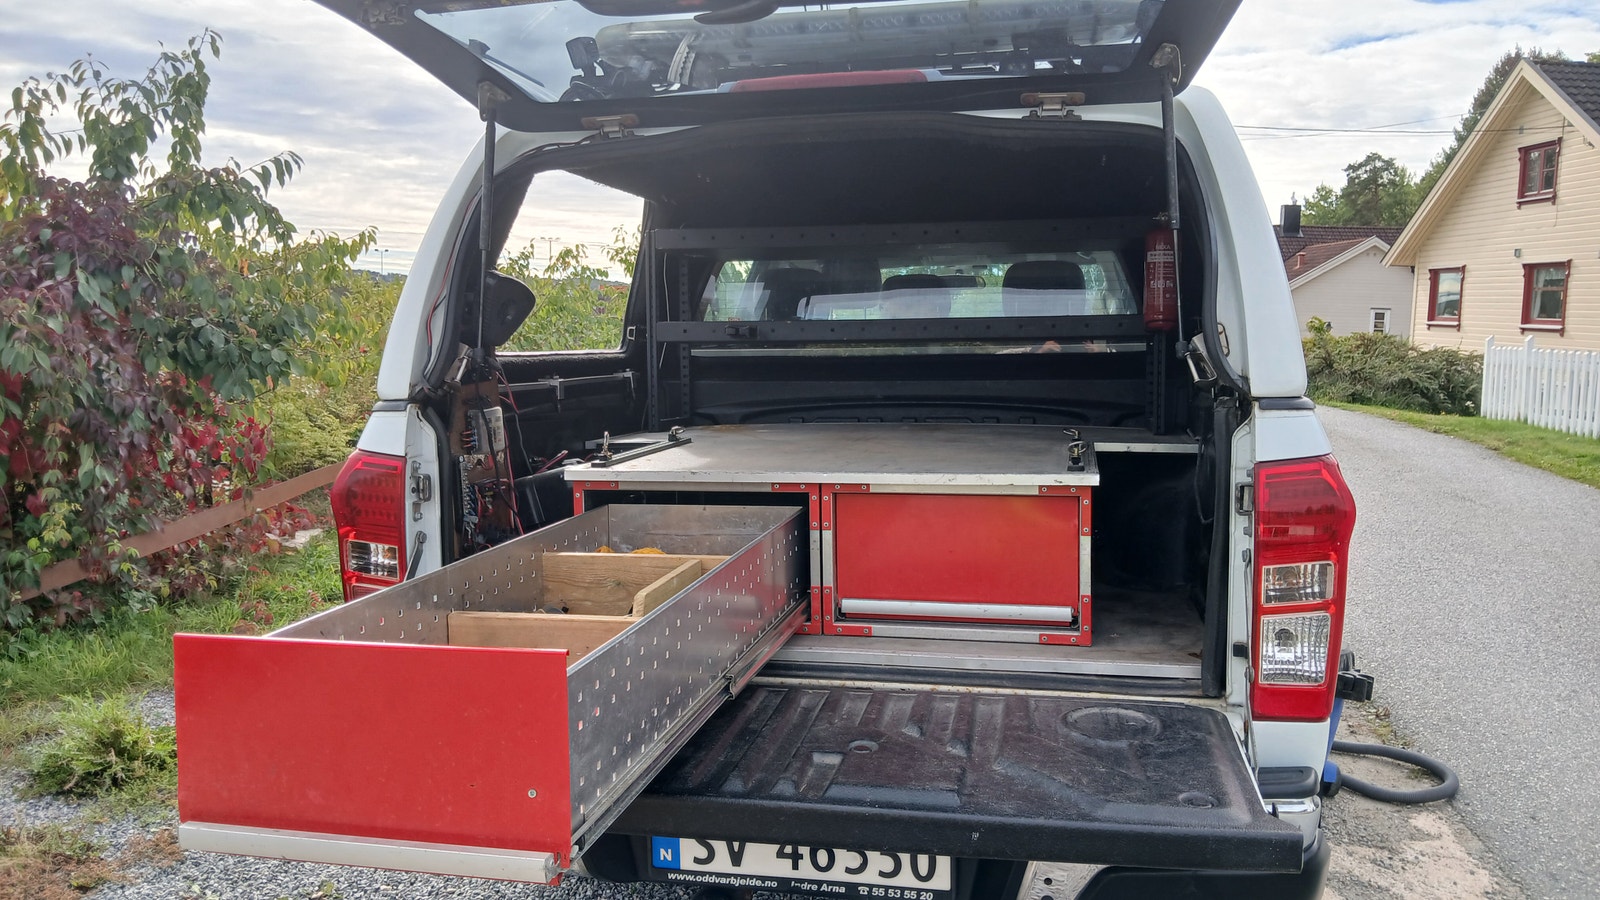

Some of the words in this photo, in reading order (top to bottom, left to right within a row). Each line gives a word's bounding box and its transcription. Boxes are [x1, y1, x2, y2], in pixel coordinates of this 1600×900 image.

[659, 848, 672, 861] N
[693, 839, 747, 867] SV
[667, 873, 778, 888] www.oddvarbjelde.no
[820, 883, 846, 893] Arna
[871, 887, 885, 896] 55
[887, 888, 901, 898] 53
[903, 890, 918, 899] 55
[919, 891, 934, 900] 20
